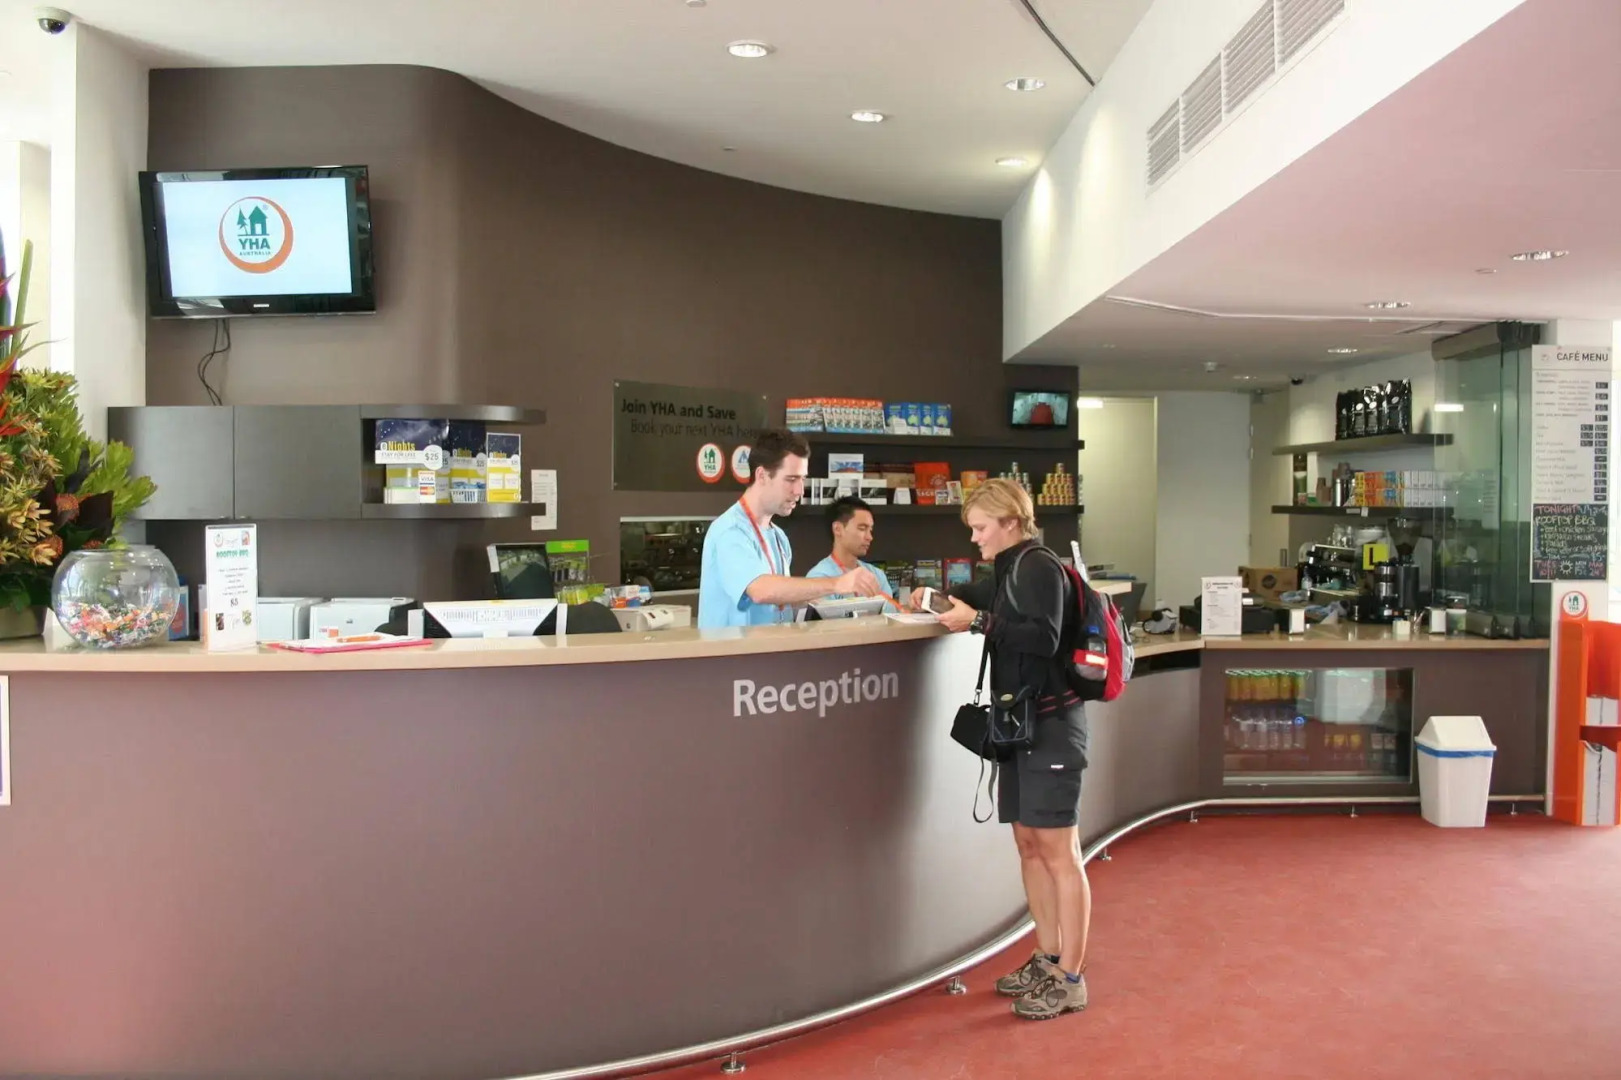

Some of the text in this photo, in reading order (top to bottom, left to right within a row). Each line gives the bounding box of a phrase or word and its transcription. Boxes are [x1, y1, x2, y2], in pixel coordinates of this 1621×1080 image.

[238, 237, 271, 250] YHA
[1556, 350, 1609, 362] CAFÉ MENU
[621, 399, 736, 422] Join YHA and Save
[631, 418, 656, 436] Book
[660, 424, 684, 438] your
[686, 425, 708, 437] next
[710, 424, 734, 438] YHA
[424, 452, 439, 461] $25
[703, 463, 717, 471] YHA
[1535, 515, 1573, 526] ROOFTOP
[733, 668, 899, 718] Reception
